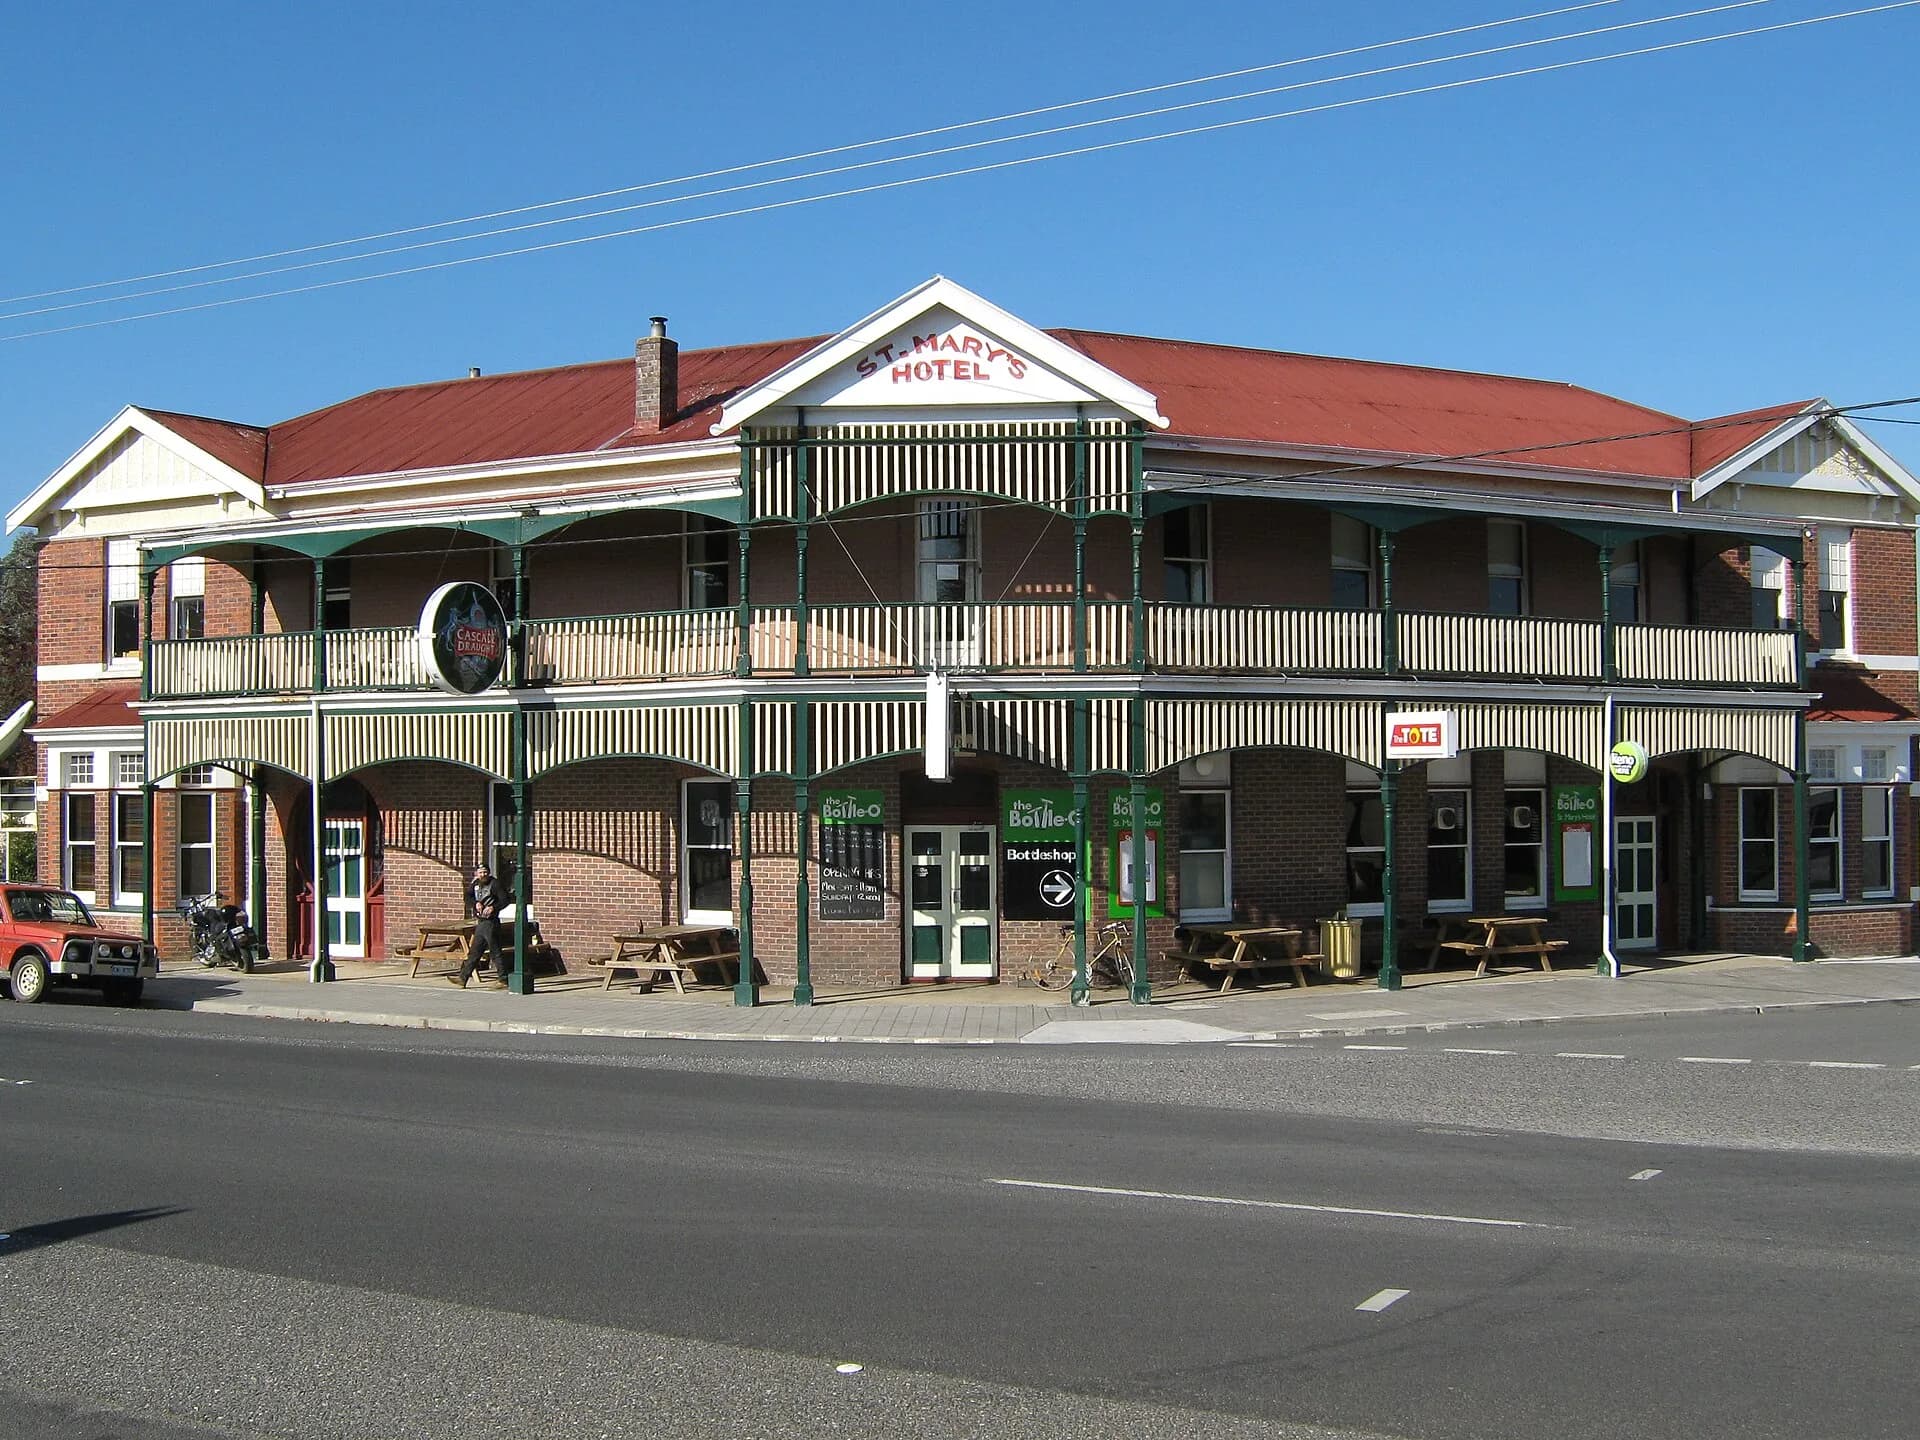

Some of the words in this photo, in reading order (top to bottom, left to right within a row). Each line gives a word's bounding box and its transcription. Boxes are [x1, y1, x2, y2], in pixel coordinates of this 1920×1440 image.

[912, 334, 1028, 380] MARY'S
[892, 359, 990, 384] HOTEL
[457, 628, 497, 645] CASCADE
[457, 641, 496, 655] DRAUGHT
[1401, 727, 1438, 744] TOTE
[823, 795, 881, 819] Bottle-O
[825, 796, 841, 805] the
[1013, 800, 1032, 810] the
[1115, 795, 1129, 803] the
[1007, 848, 1077, 864] Bottleshop
